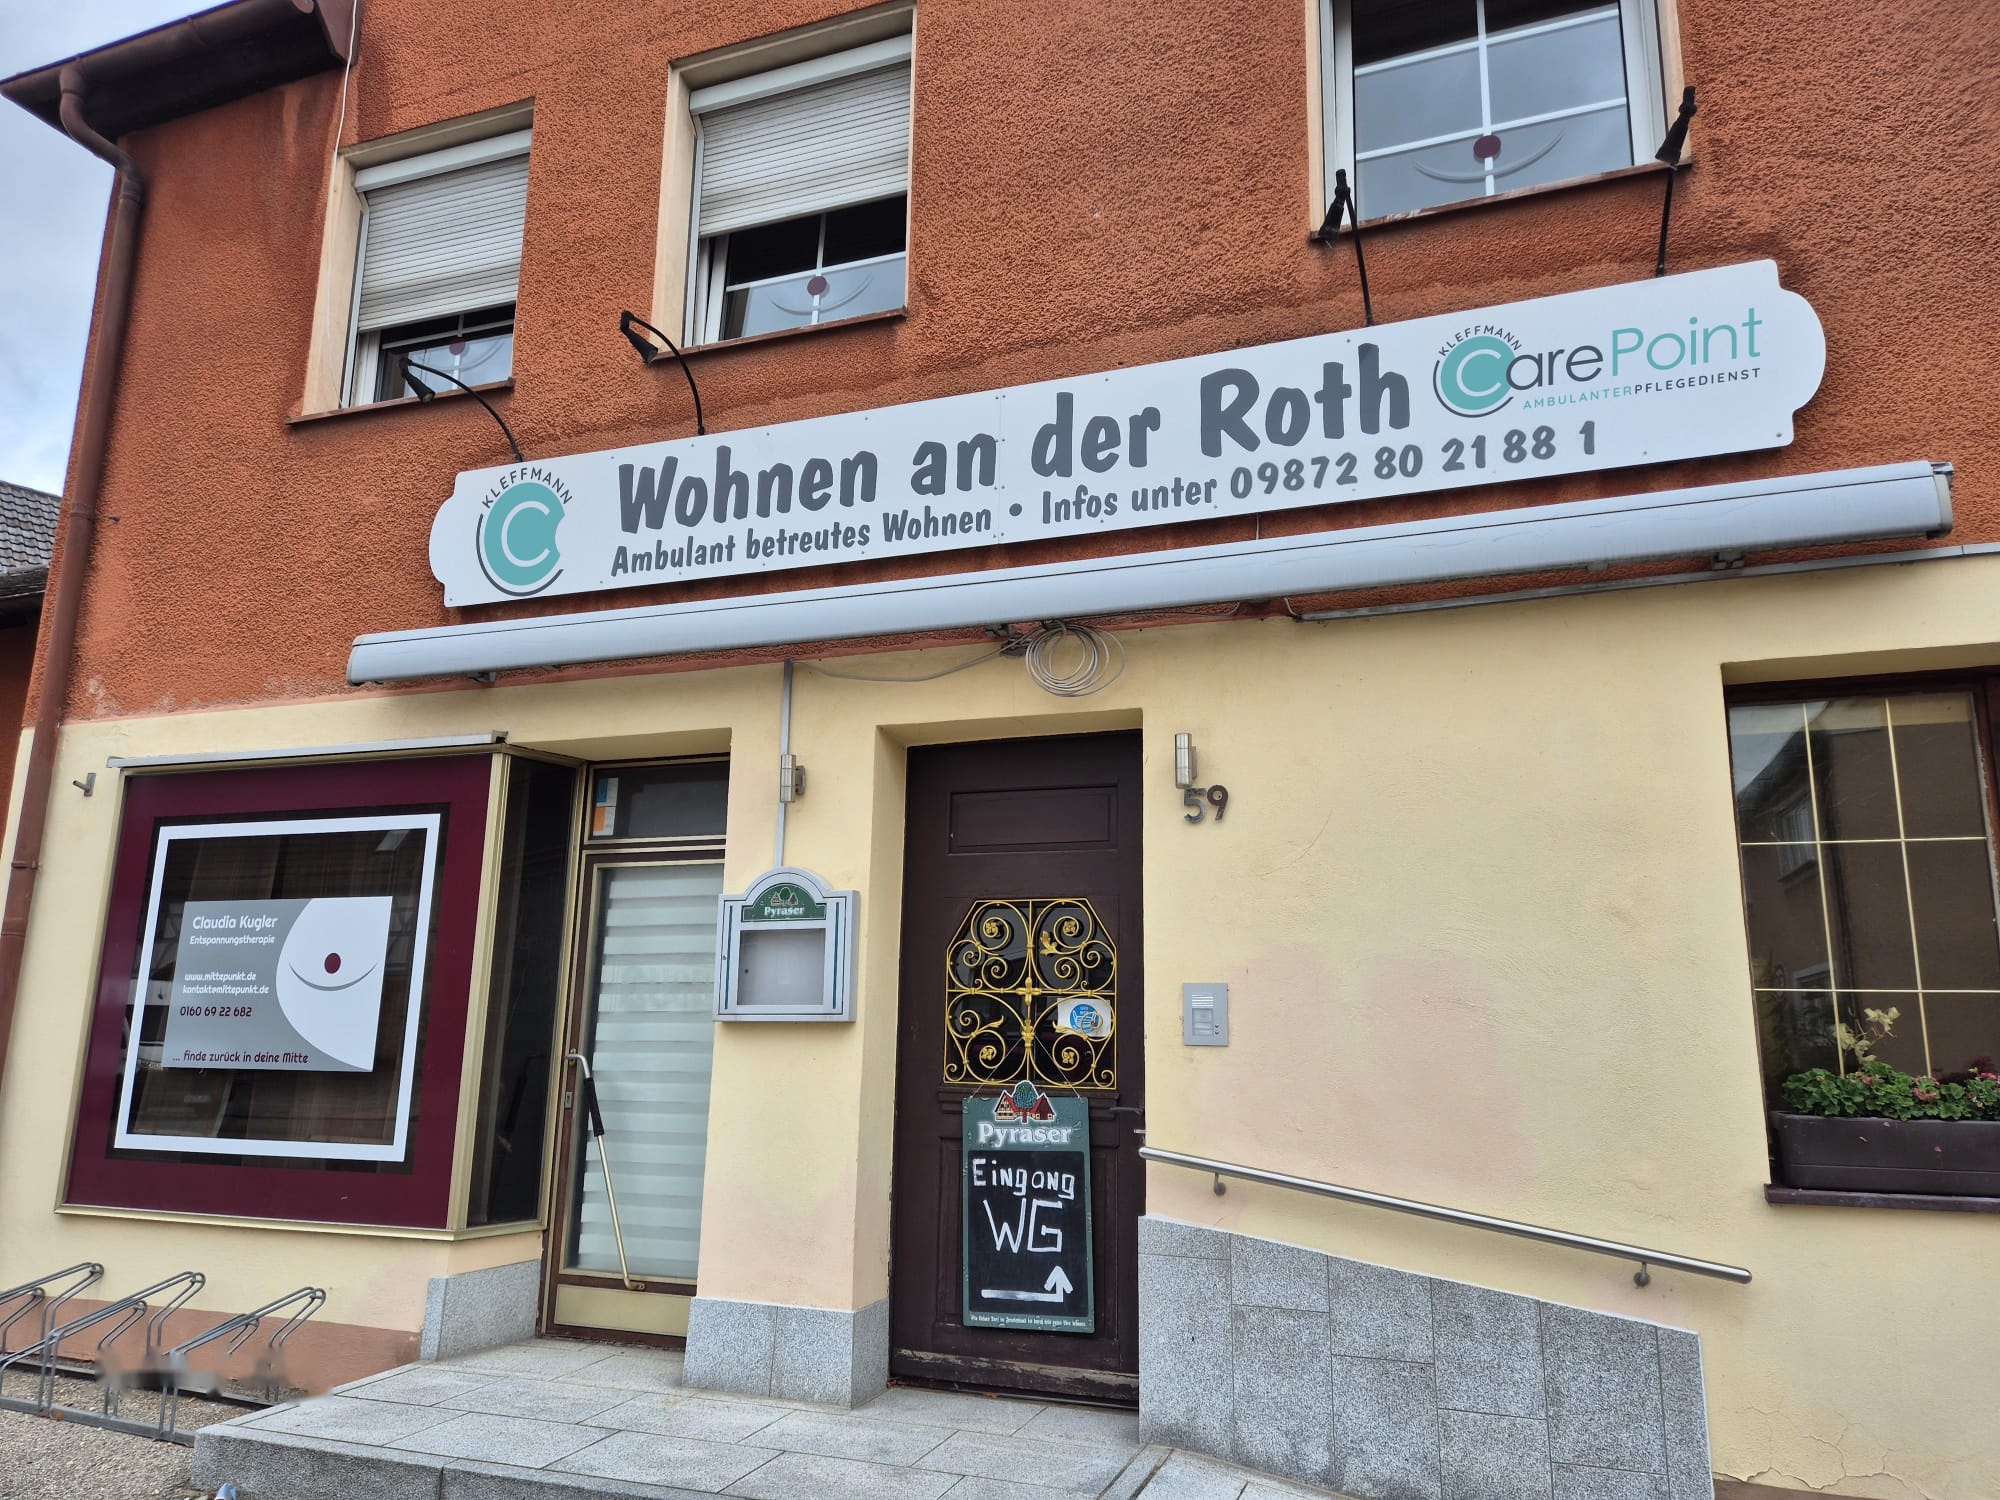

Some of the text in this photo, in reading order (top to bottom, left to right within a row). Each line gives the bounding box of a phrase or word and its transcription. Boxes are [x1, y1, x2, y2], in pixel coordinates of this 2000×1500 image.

[1439, 325, 1522, 357] KLEFFMANN
[618, 342, 1411, 534] Wohnen an der Roth
[482, 466, 573, 508] KLEFFMANN
[610, 420, 1596, 577] Ambulant betreutes Wohnen Infos unter 09872 80 21 88 1
[1184, 784, 1229, 824] 59
[192, 914, 278, 930] Claudia Kugler
[764, 906, 805, 918] Pyraser
[189, 934, 275, 946] Entspannungstherapie
[184, 971, 257, 983] www.mittepunkt.de
[182, 984, 270, 996] kontakt@mittepunkt.de
[180, 1006, 252, 1017] 0160 69 22 682
[183, 1050, 206, 1062] finde
[209, 1050, 240, 1062] zurück
[243, 1051, 251, 1063] in
[254, 1051, 280, 1063] deine
[282, 1051, 309, 1064] Mitte
[977, 1122, 1073, 1147] Pyraser
[982, 1197, 1063, 1254] WG
